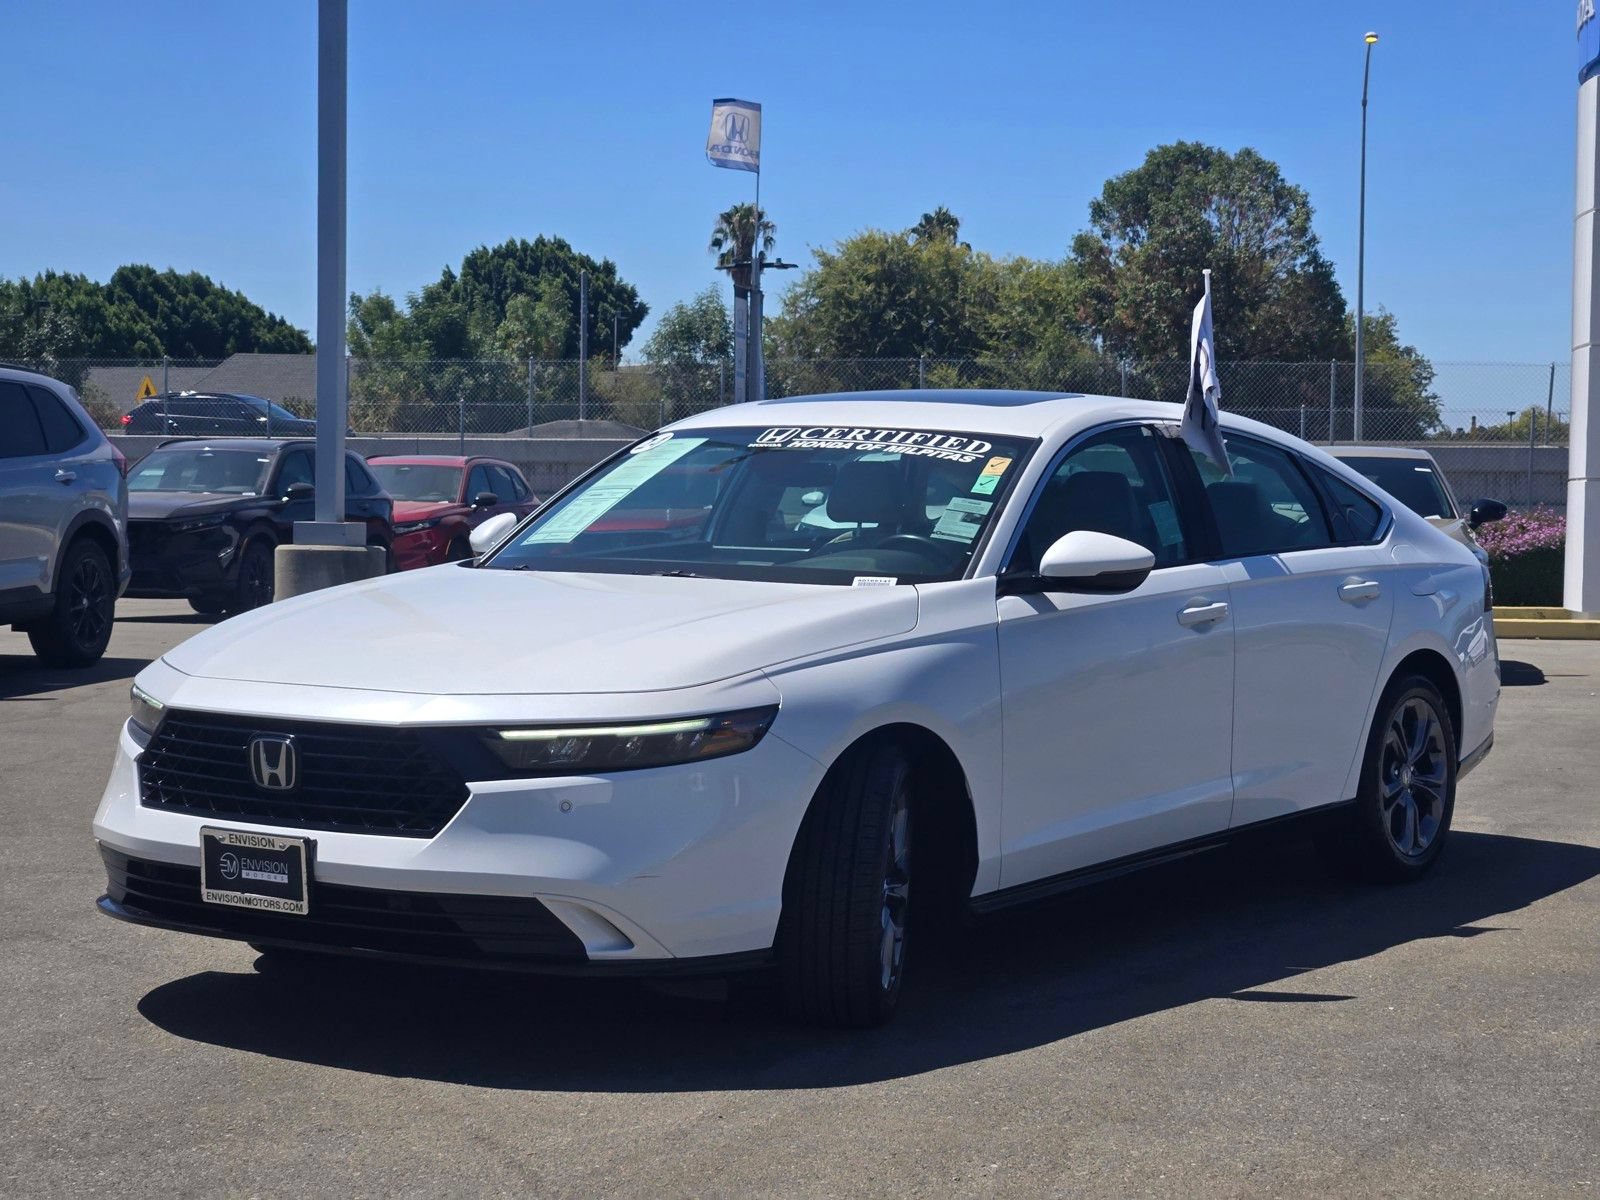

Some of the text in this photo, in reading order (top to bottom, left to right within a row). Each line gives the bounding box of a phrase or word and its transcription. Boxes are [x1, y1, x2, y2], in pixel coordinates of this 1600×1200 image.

[800, 427, 992, 454] CERTIFIED
[786, 440, 976, 463] HONDA OF MILPITAS
[228, 833, 275, 849] ENVISION
[241, 857, 288, 874] ENVISION
[244, 870, 285, 882] MOTORS
[206, 891, 304, 913] ENVISIONMOTORS.COM
